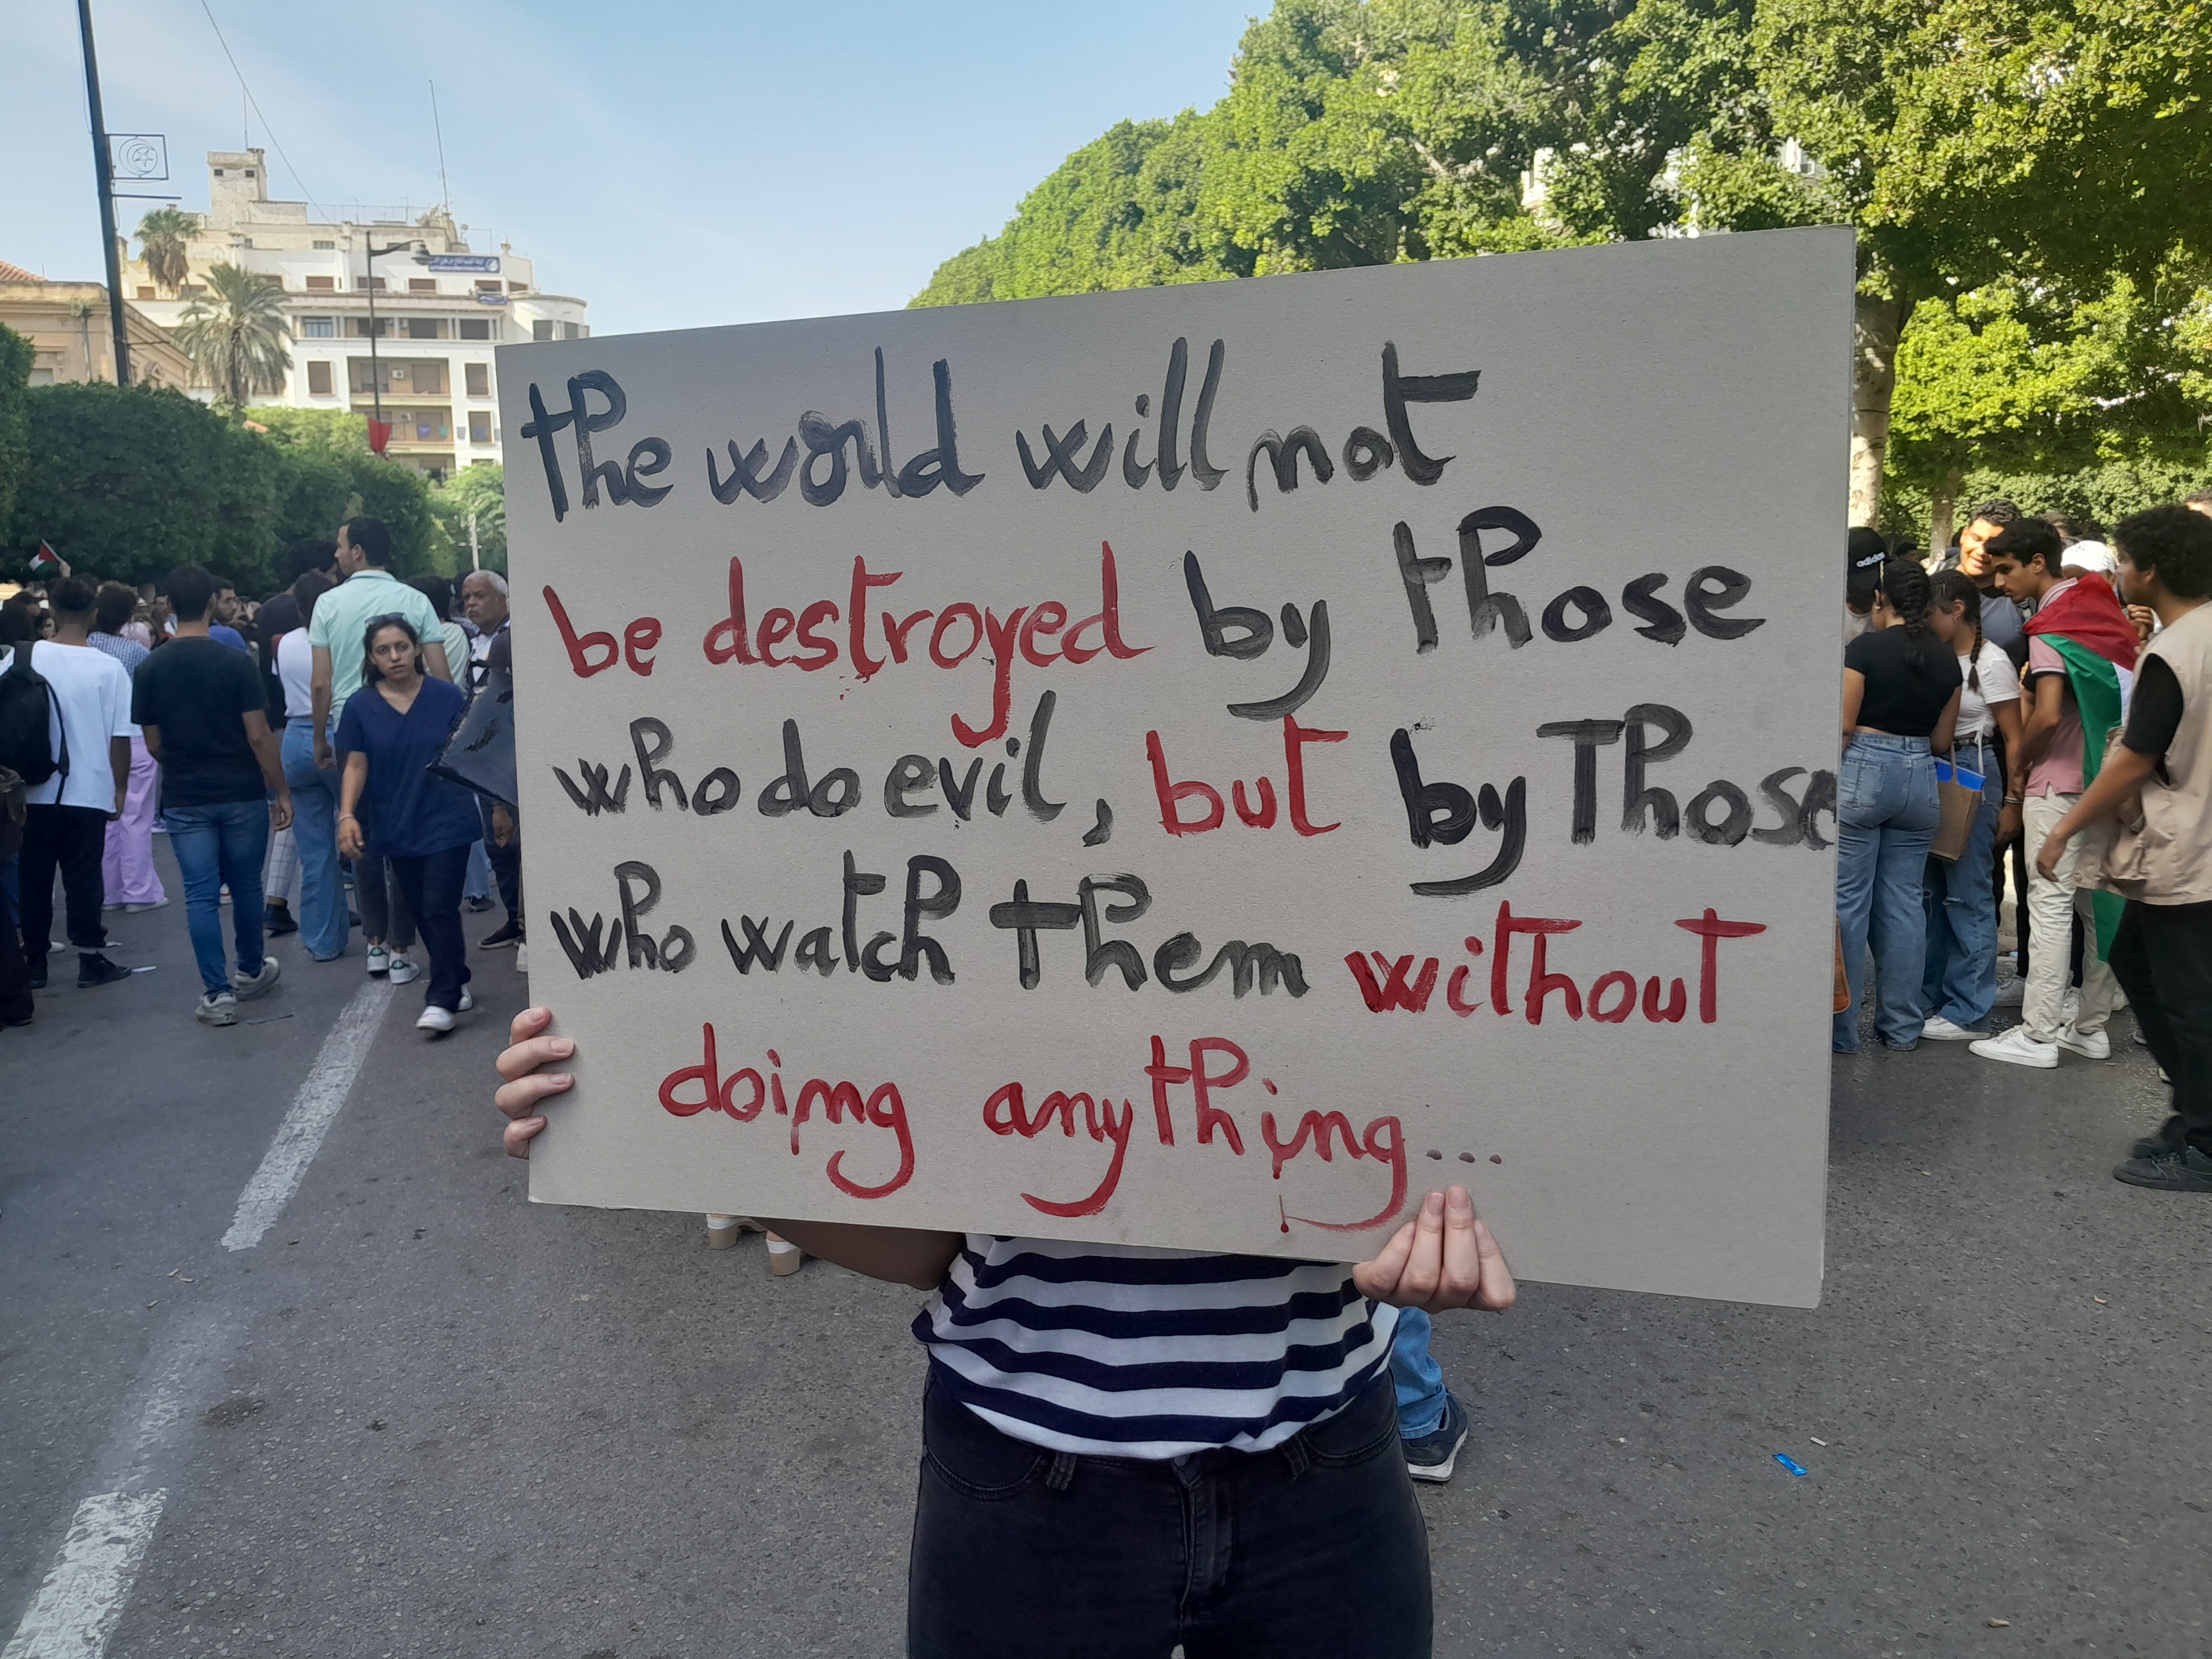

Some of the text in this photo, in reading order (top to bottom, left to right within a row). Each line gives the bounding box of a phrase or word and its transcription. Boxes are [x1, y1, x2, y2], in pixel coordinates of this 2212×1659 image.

[520, 337, 1482, 523] the world will not
[543, 505, 1767, 749] be destroyed by those
[552, 717, 742, 818] who
[757, 718, 863, 819] do
[1146, 713, 1349, 838] but
[1390, 728, 1527, 897] by
[550, 849, 1768, 1026] who watch them without
[658, 1021, 916, 1200] doing
